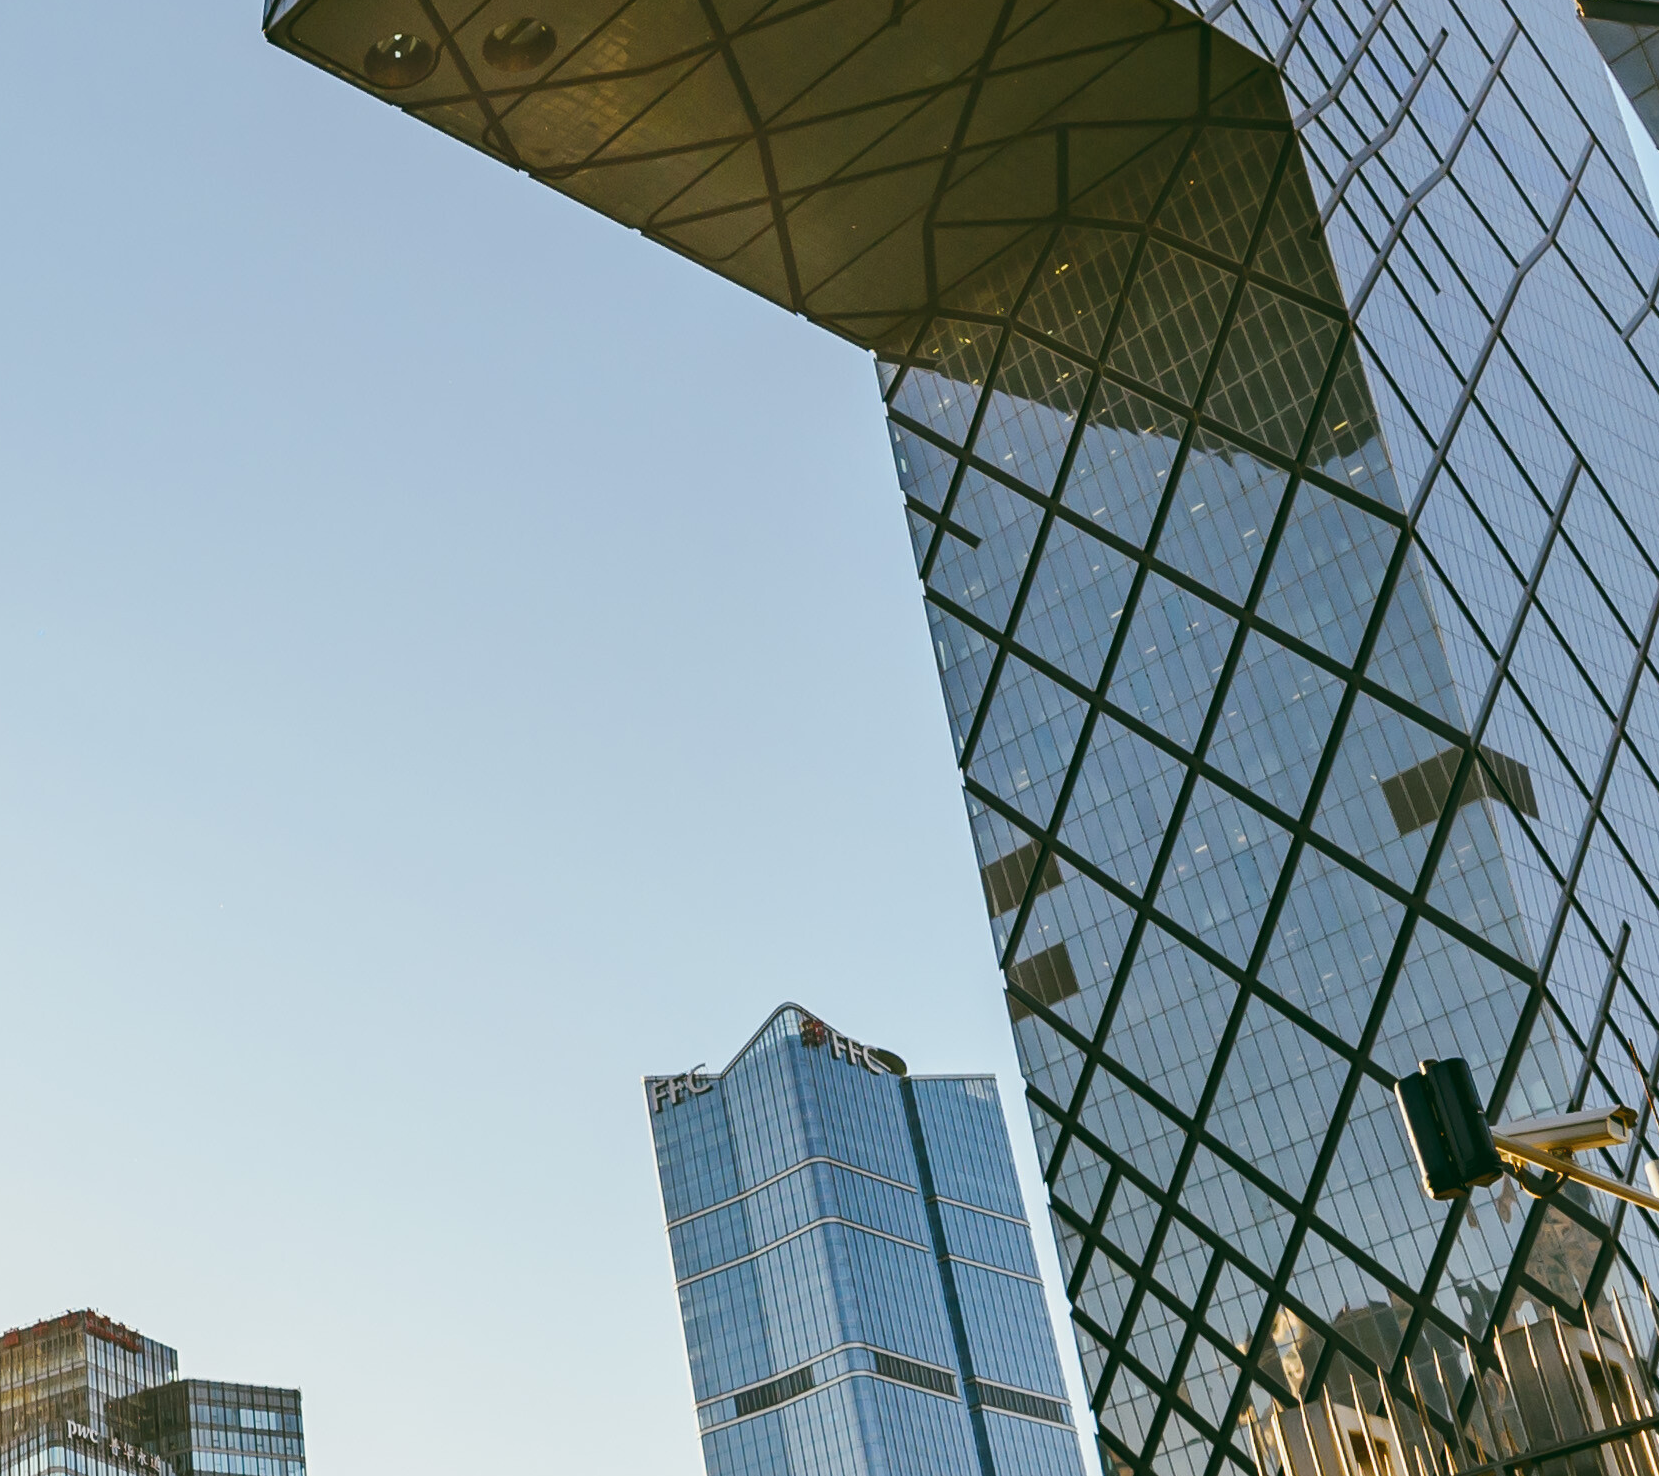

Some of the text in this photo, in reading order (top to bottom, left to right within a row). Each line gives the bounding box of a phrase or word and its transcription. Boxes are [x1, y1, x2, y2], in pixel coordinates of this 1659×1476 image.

[832, 1030, 892, 1076] FFC
[651, 1063, 712, 1112] FFC
[67, 1419, 99, 1443] pwc
